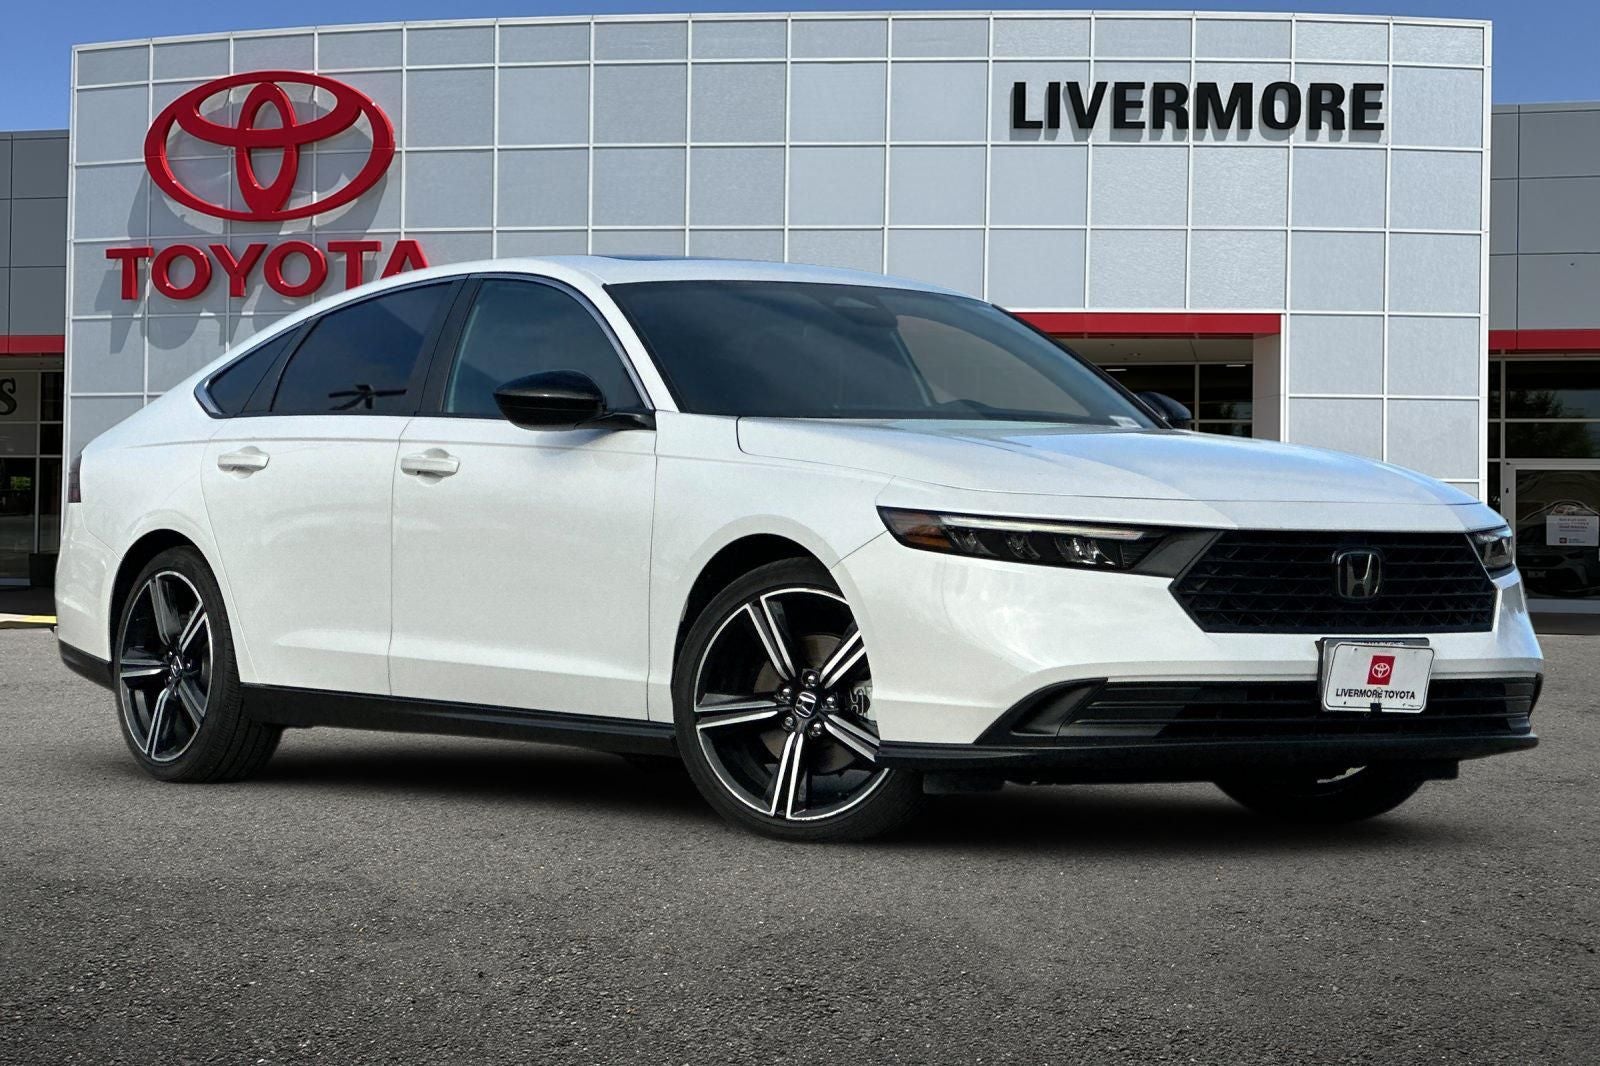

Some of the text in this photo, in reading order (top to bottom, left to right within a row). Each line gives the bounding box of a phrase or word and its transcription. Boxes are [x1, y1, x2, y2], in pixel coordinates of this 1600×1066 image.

[1012, 81, 1385, 131] LIVERMORE
[105, 239, 430, 300] TOYOTA
[1335, 688, 1416, 700] LIVERMORE TOYOTA
